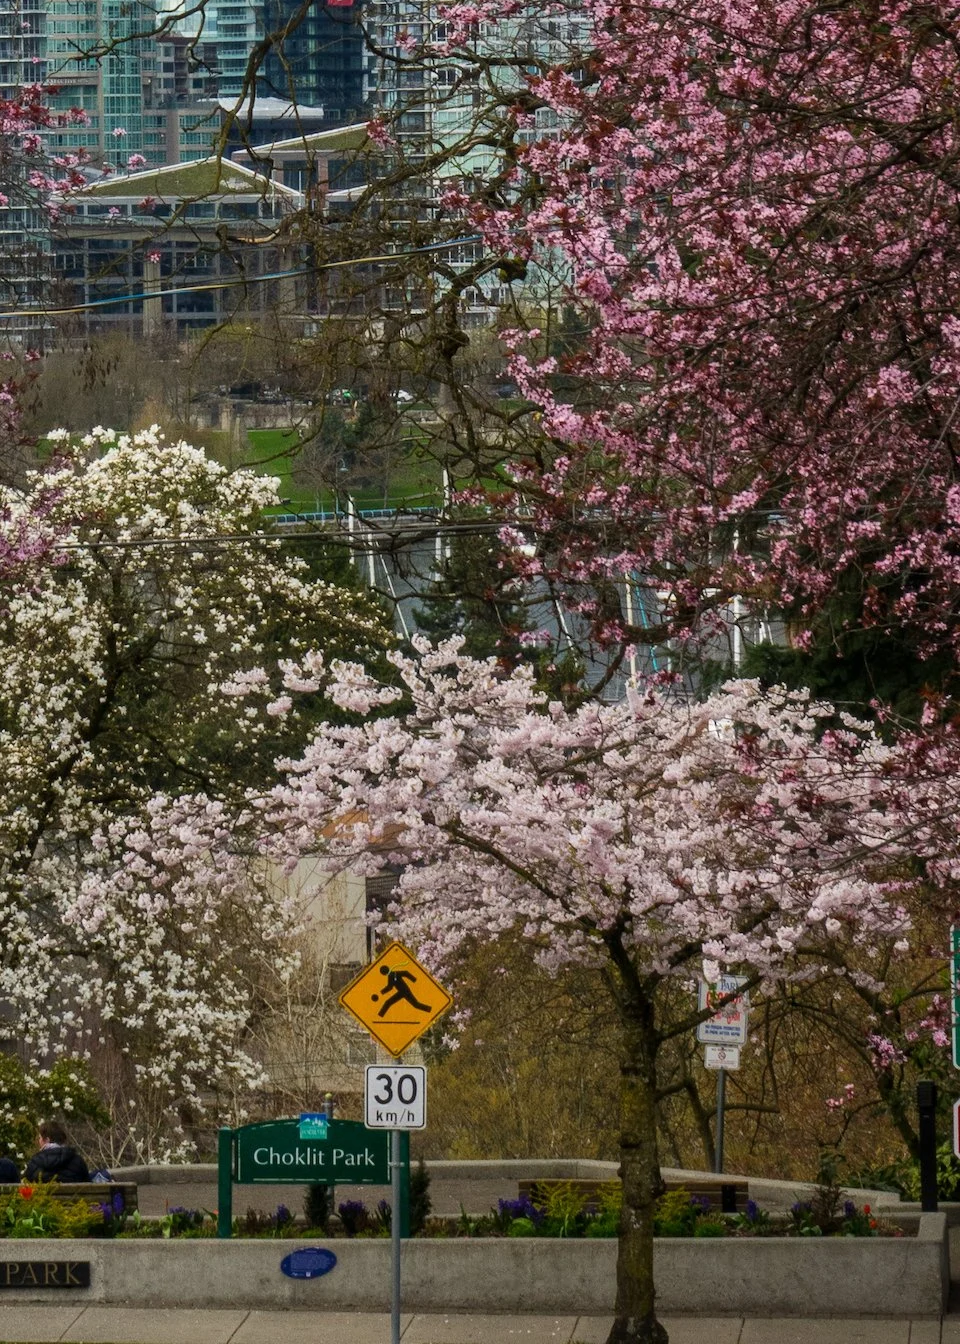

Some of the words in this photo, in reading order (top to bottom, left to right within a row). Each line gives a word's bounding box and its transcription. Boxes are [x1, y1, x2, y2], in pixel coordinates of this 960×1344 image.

[374, 1074, 417, 1105] 30
[376, 1108, 415, 1124] km/h
[253, 1147, 325, 1166] Choklit
[332, 1148, 376, 1166] Park
[5, 1263, 81, 1285] PARK
